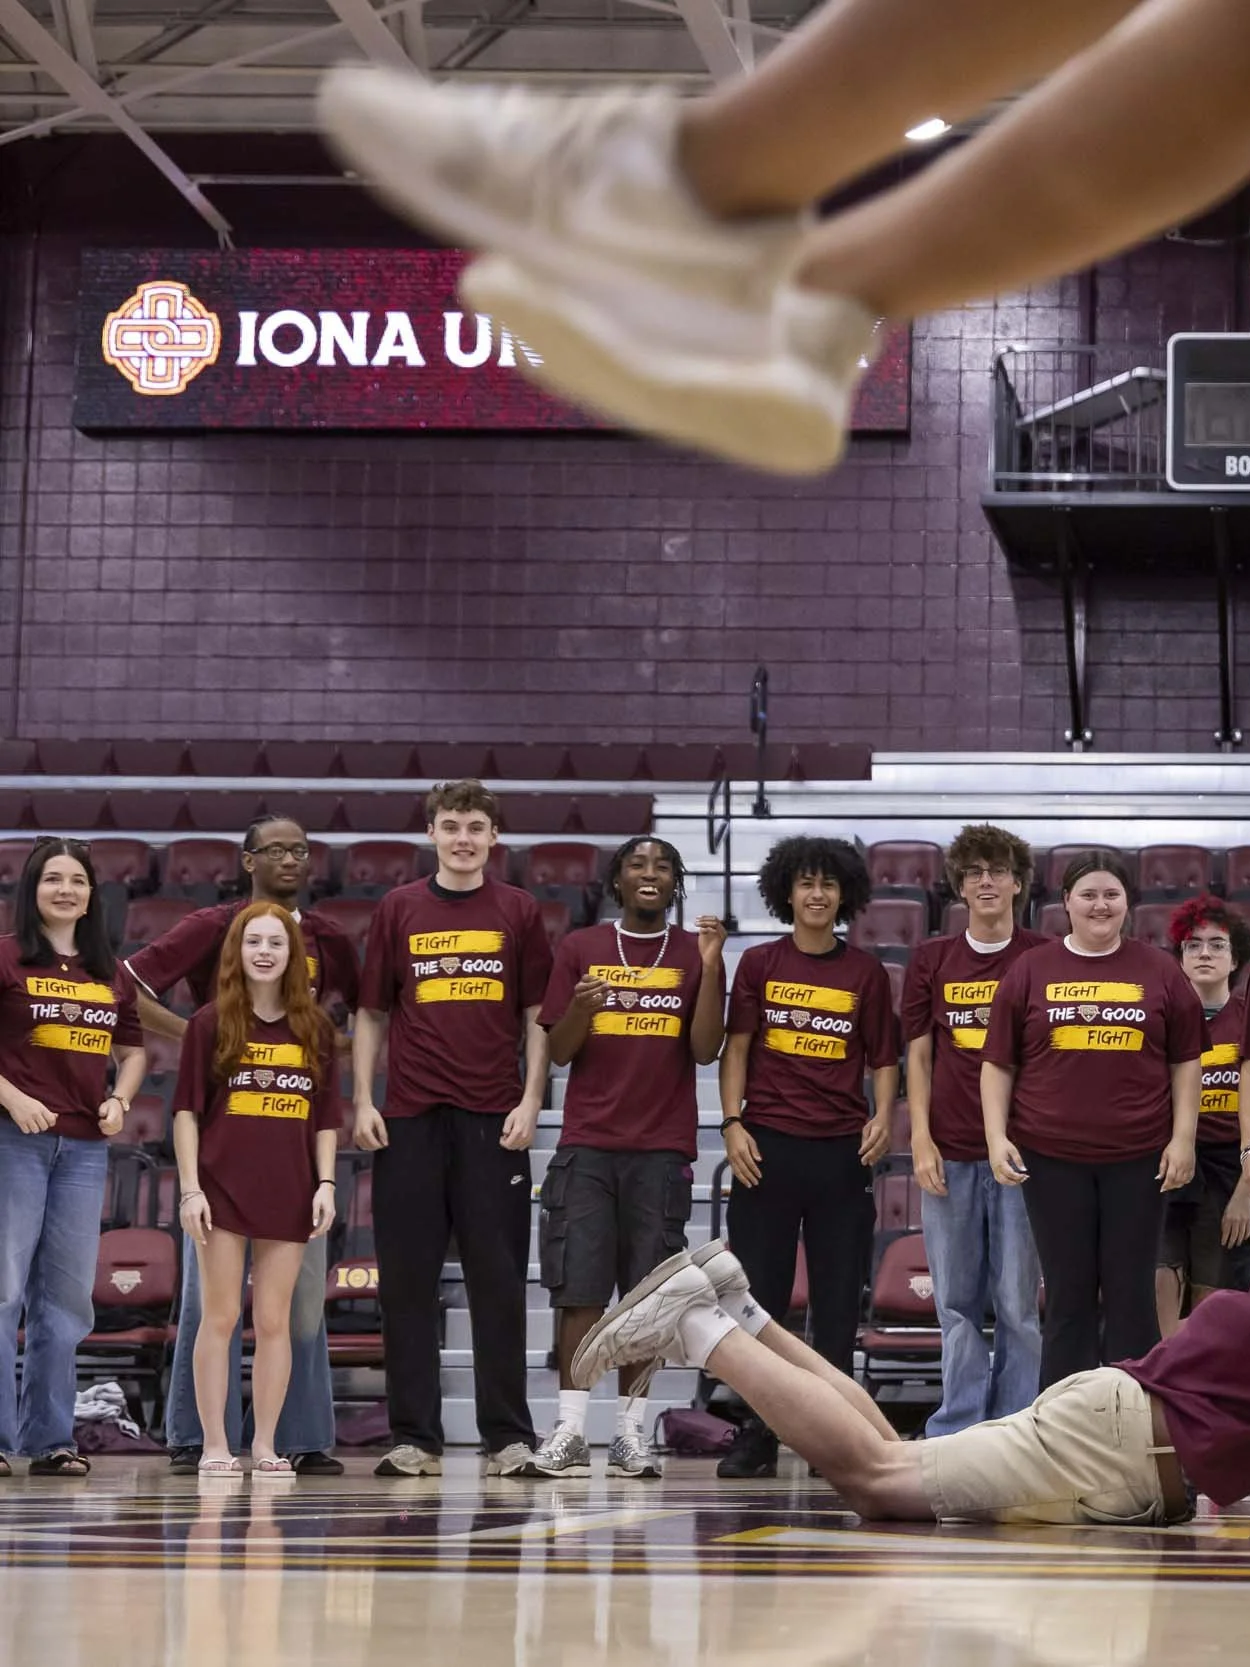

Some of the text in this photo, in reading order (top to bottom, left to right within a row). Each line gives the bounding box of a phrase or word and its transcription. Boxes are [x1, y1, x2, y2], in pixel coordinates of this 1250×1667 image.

[236, 309, 426, 368] IONA
[416, 934, 460, 952] FIGHT
[412, 961, 439, 977] THE
[462, 959, 504, 973] GOOD
[35, 980, 79, 997] FIGHT
[449, 981, 492, 997] FIGHT
[771, 985, 816, 1003] FIGHT
[952, 984, 995, 1000] FIGHT
[1054, 985, 1101, 998] FIGHT
[640, 995, 682, 1008] GOOD
[30, 1003, 61, 1020] THE
[946, 1010, 973, 1026] THE
[1046, 1006, 1076, 1023] THE
[1102, 1007, 1146, 1022] GOOD
[626, 1016, 670, 1032] FIGHT
[765, 1009, 789, 1023] THE
[812, 1016, 853, 1033] GOOD
[69, 1030, 110, 1051] FIGHT
[794, 1036, 841, 1055] FIGHT
[1087, 1030, 1133, 1046] FIGHT
[244, 1047, 276, 1062] GHT
[276, 1073, 313, 1091] GOOD
[1201, 1071, 1240, 1086] GOOD
[262, 1096, 303, 1115] FIGHT
[1201, 1093, 1231, 1108] GHT
